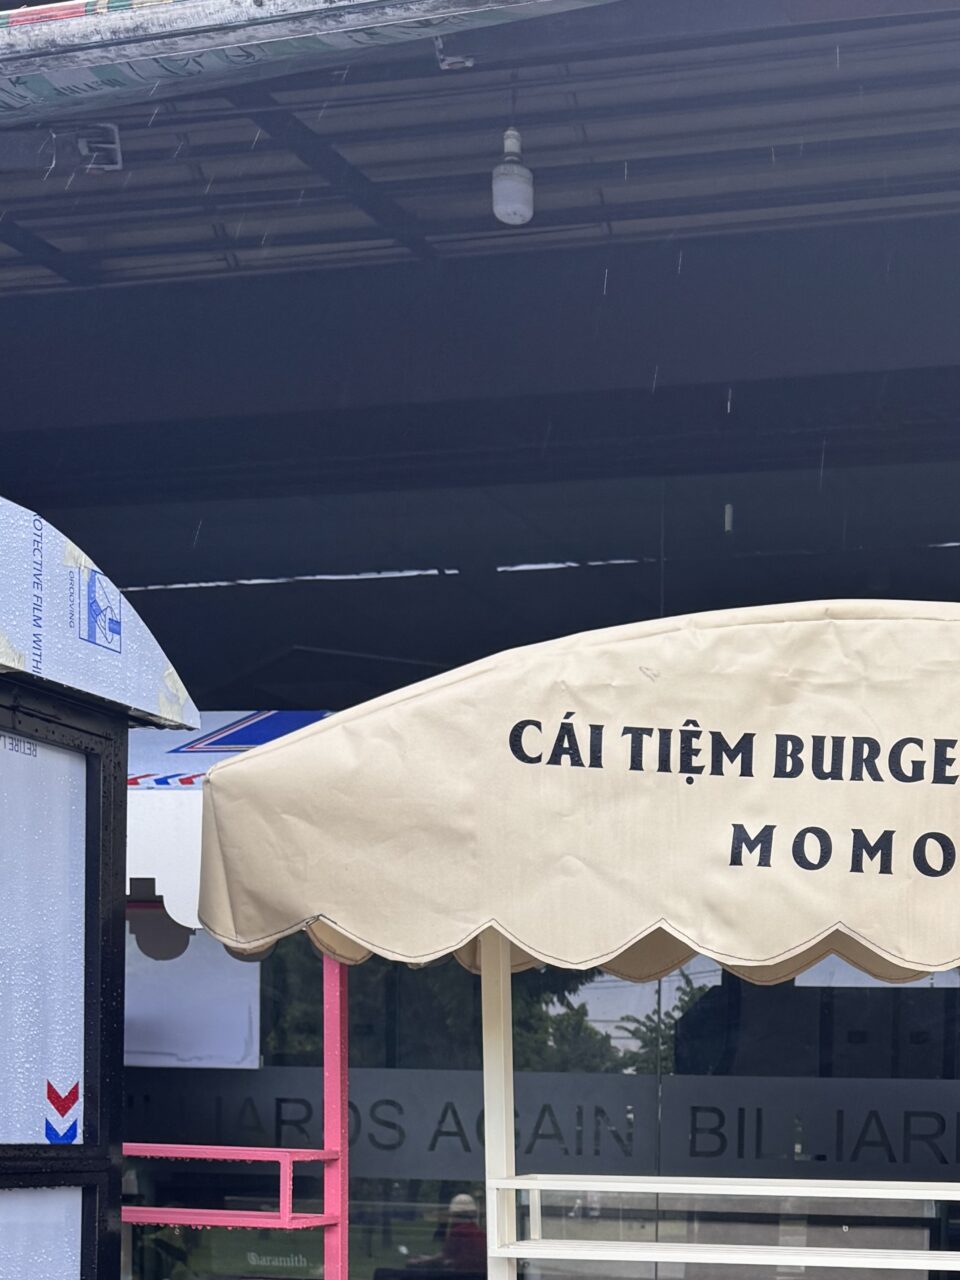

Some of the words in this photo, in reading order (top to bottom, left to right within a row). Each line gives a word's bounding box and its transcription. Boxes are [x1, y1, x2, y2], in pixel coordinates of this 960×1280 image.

[33, 594, 43, 628] FILM
[509, 711, 605, 768] CÁI
[621, 719, 756, 785] TIỆM
[729, 823, 956, 877] MOMO
